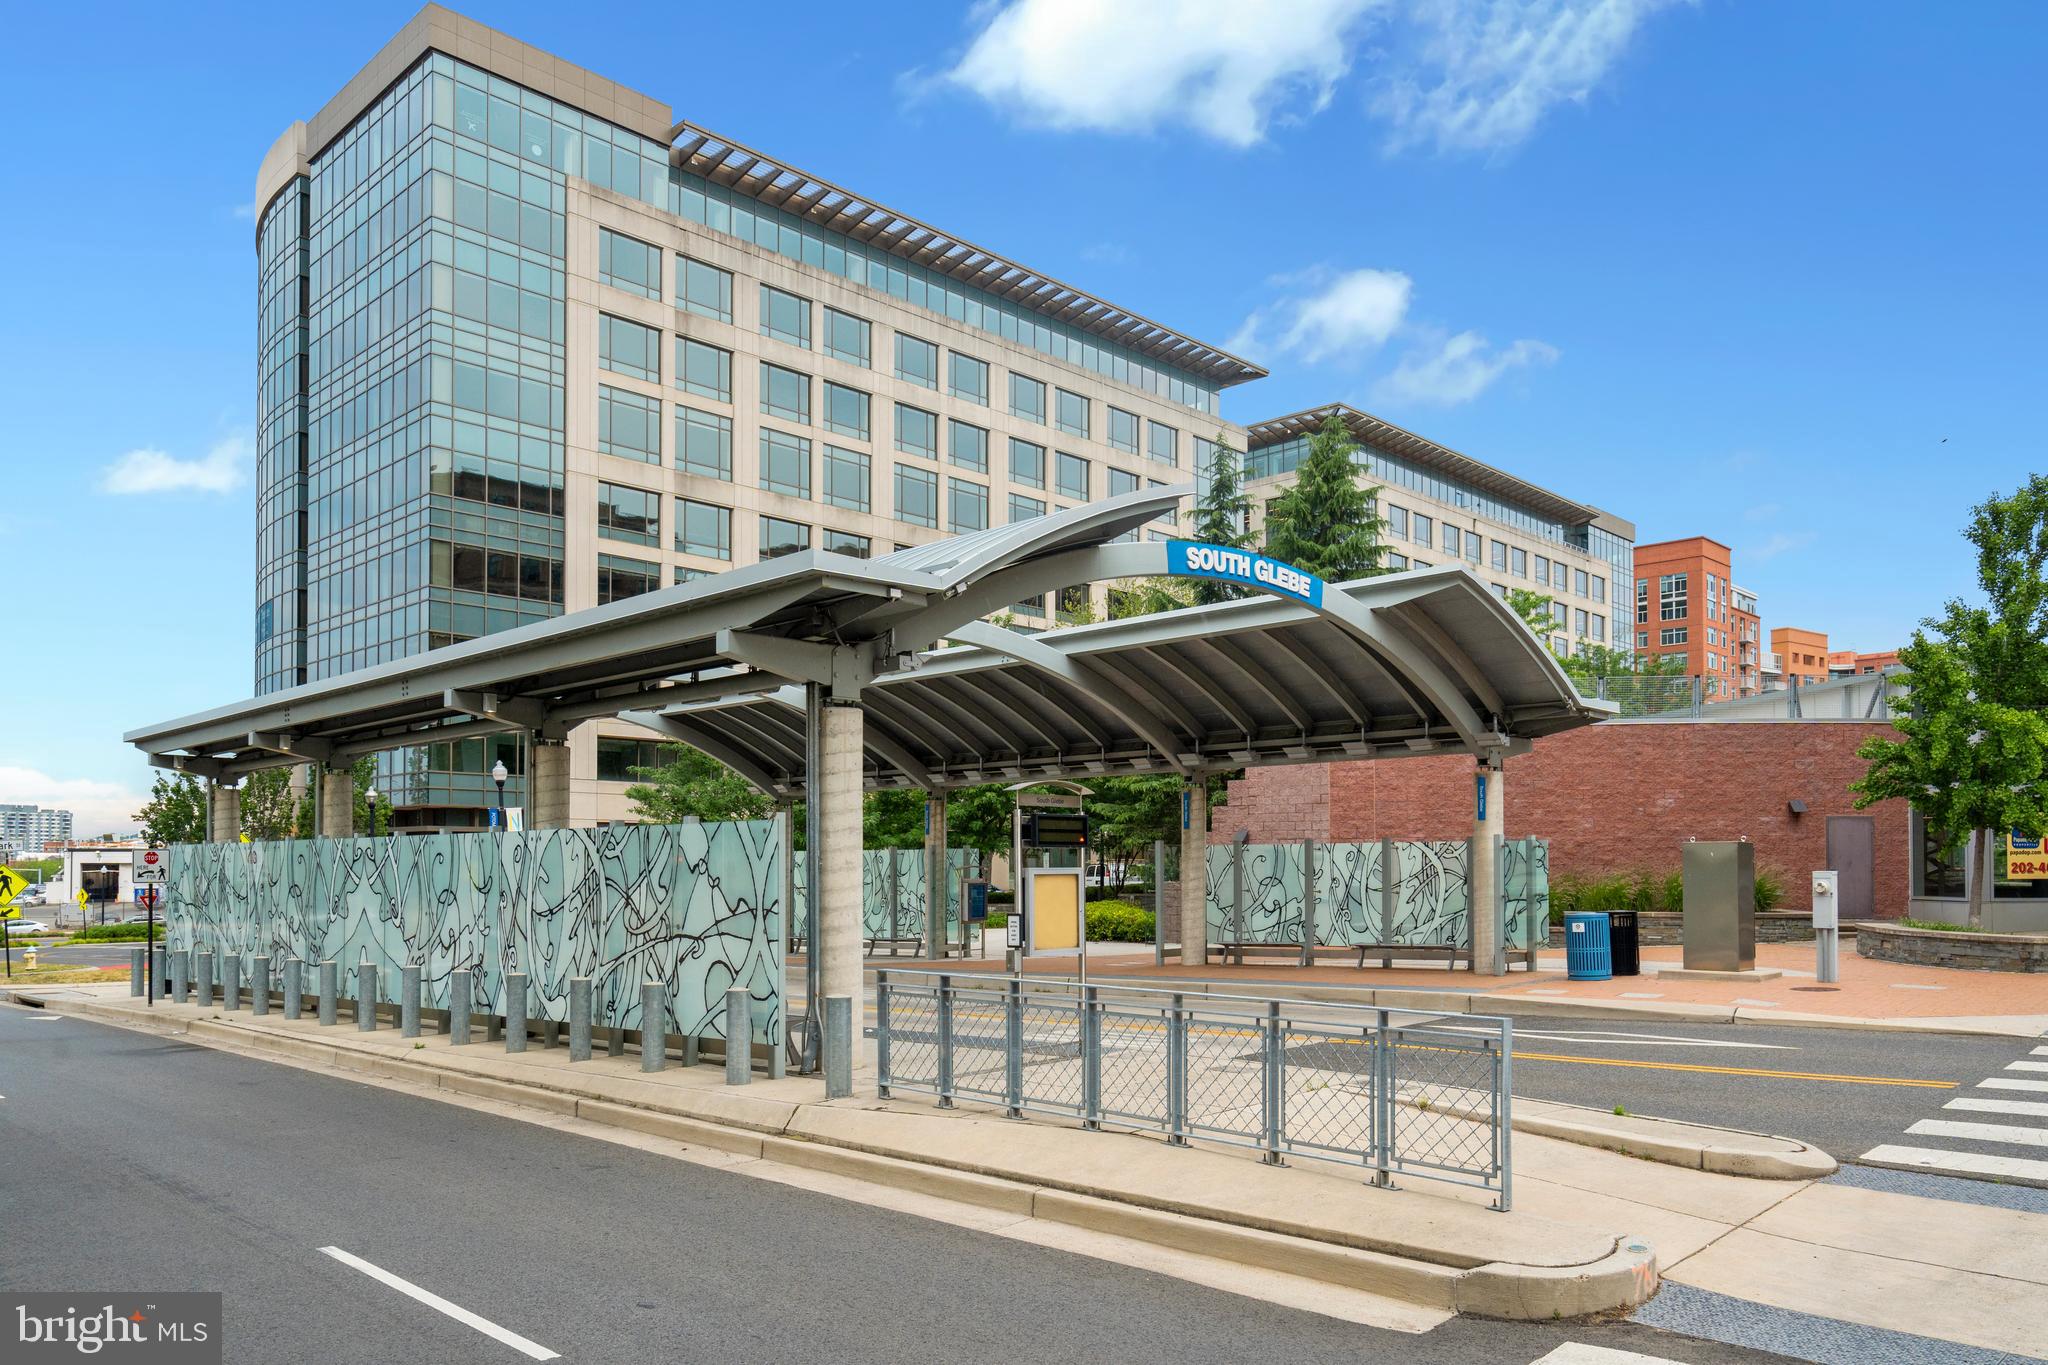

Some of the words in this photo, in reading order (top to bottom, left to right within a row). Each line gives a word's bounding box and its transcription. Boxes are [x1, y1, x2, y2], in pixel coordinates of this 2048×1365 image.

[1186, 546, 1250, 577] SOUTH
[1254, 559, 1311, 598] GLEBE
[0, 841, 13, 850] ark
[2011, 862, 2048, 874] 202-4
